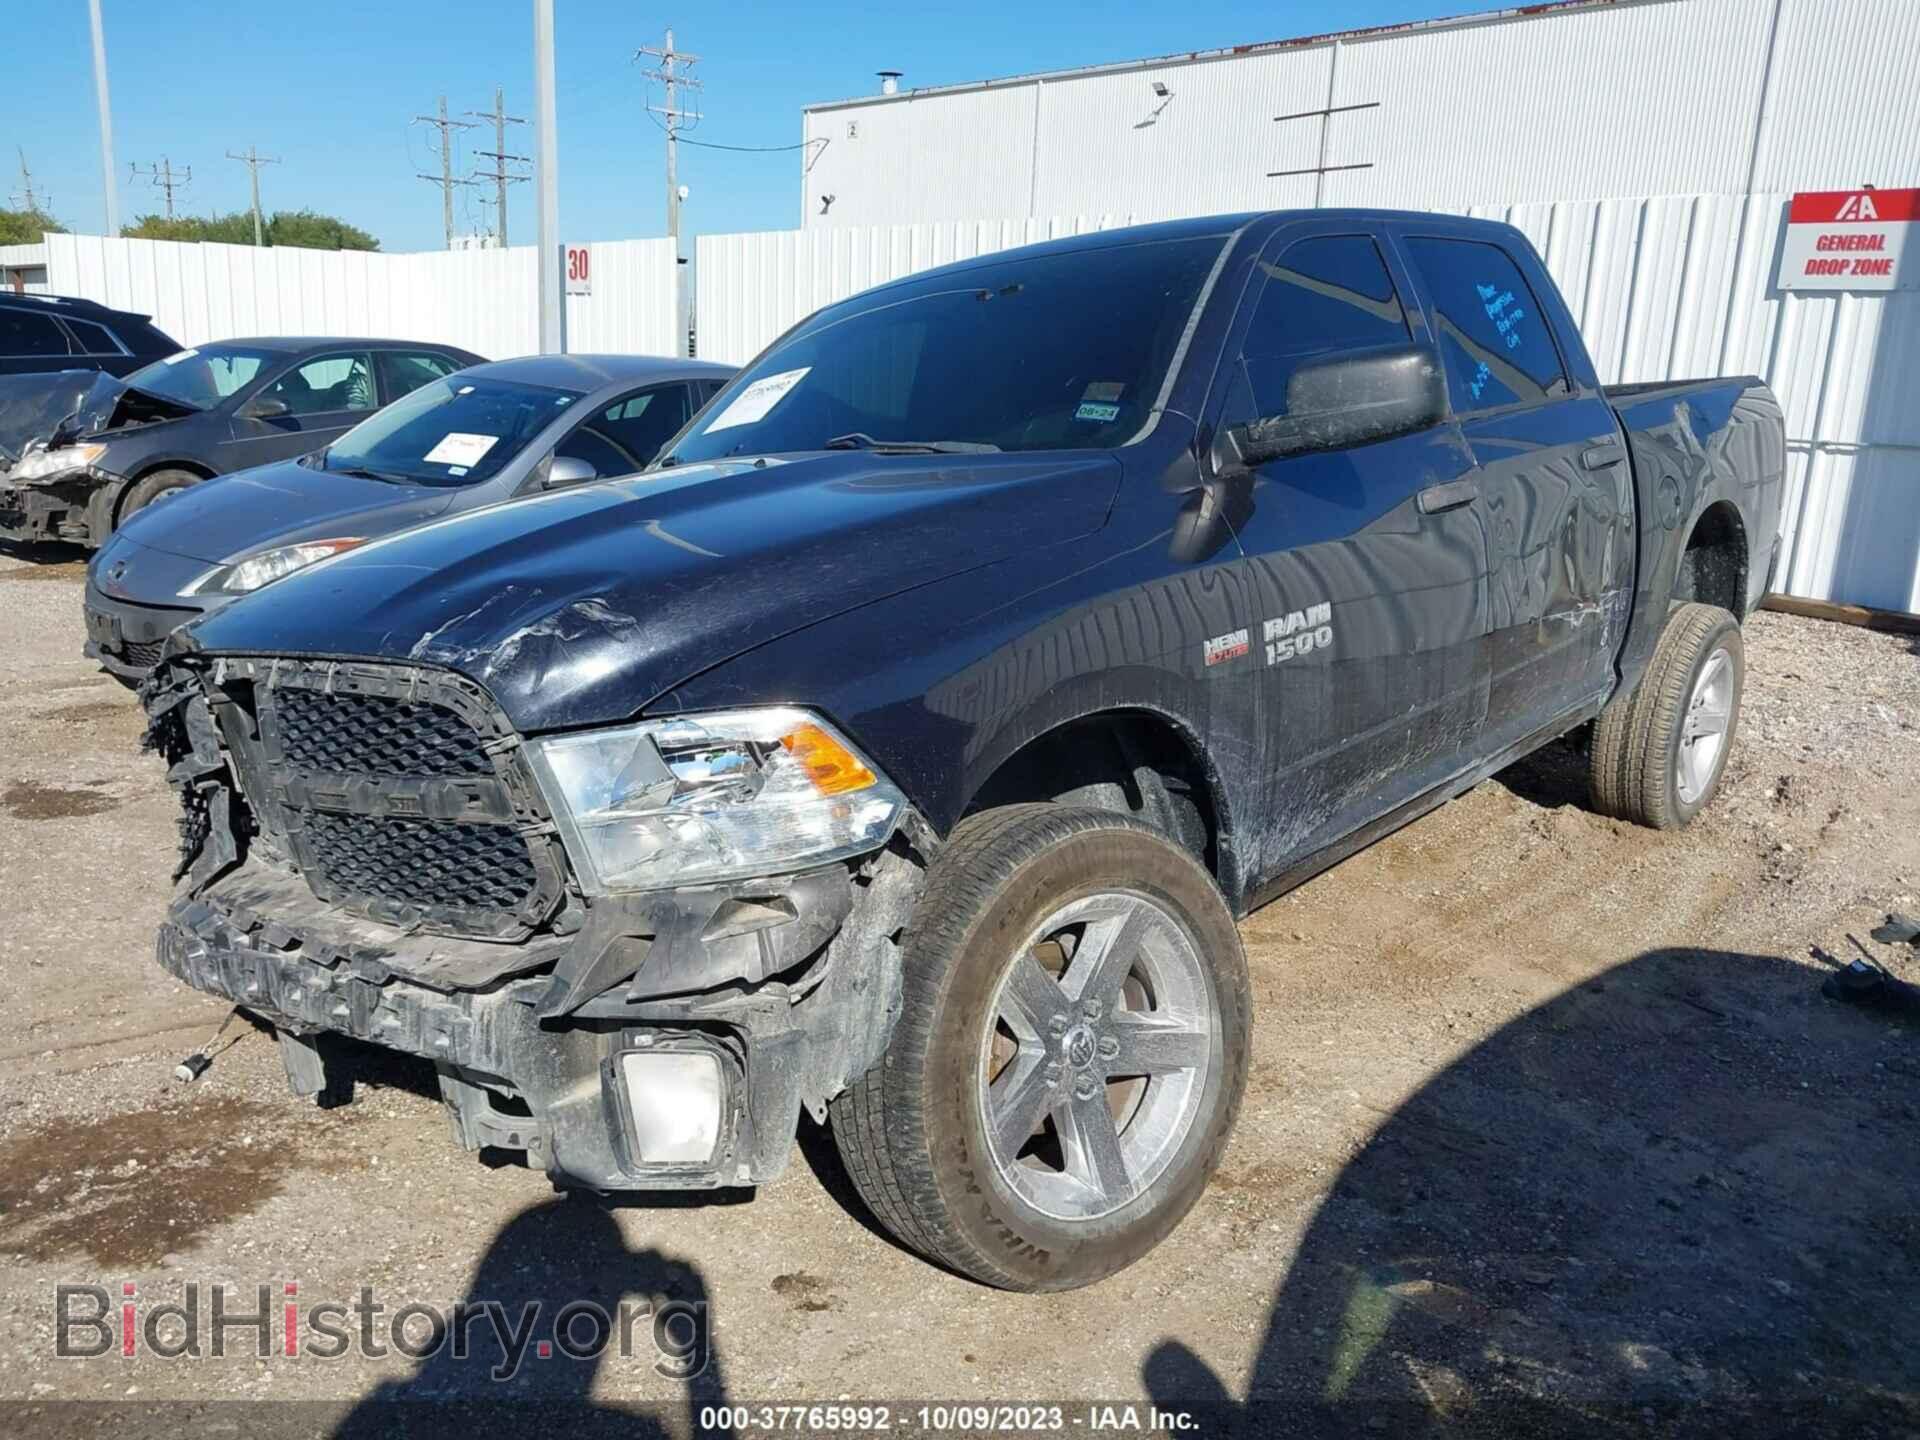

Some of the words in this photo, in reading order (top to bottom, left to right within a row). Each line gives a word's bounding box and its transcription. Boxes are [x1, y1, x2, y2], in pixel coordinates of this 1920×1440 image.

[849, 124, 856, 136] 2
[1816, 234, 1885, 252] GENERAL
[569, 249, 588, 280] 30
[1804, 258, 1850, 276] DROP
[1850, 258, 1894, 275] ZONE
[1262, 601, 1332, 641] RAM
[1203, 628, 1249, 657] HEMI
[1265, 626, 1333, 666] 1500
